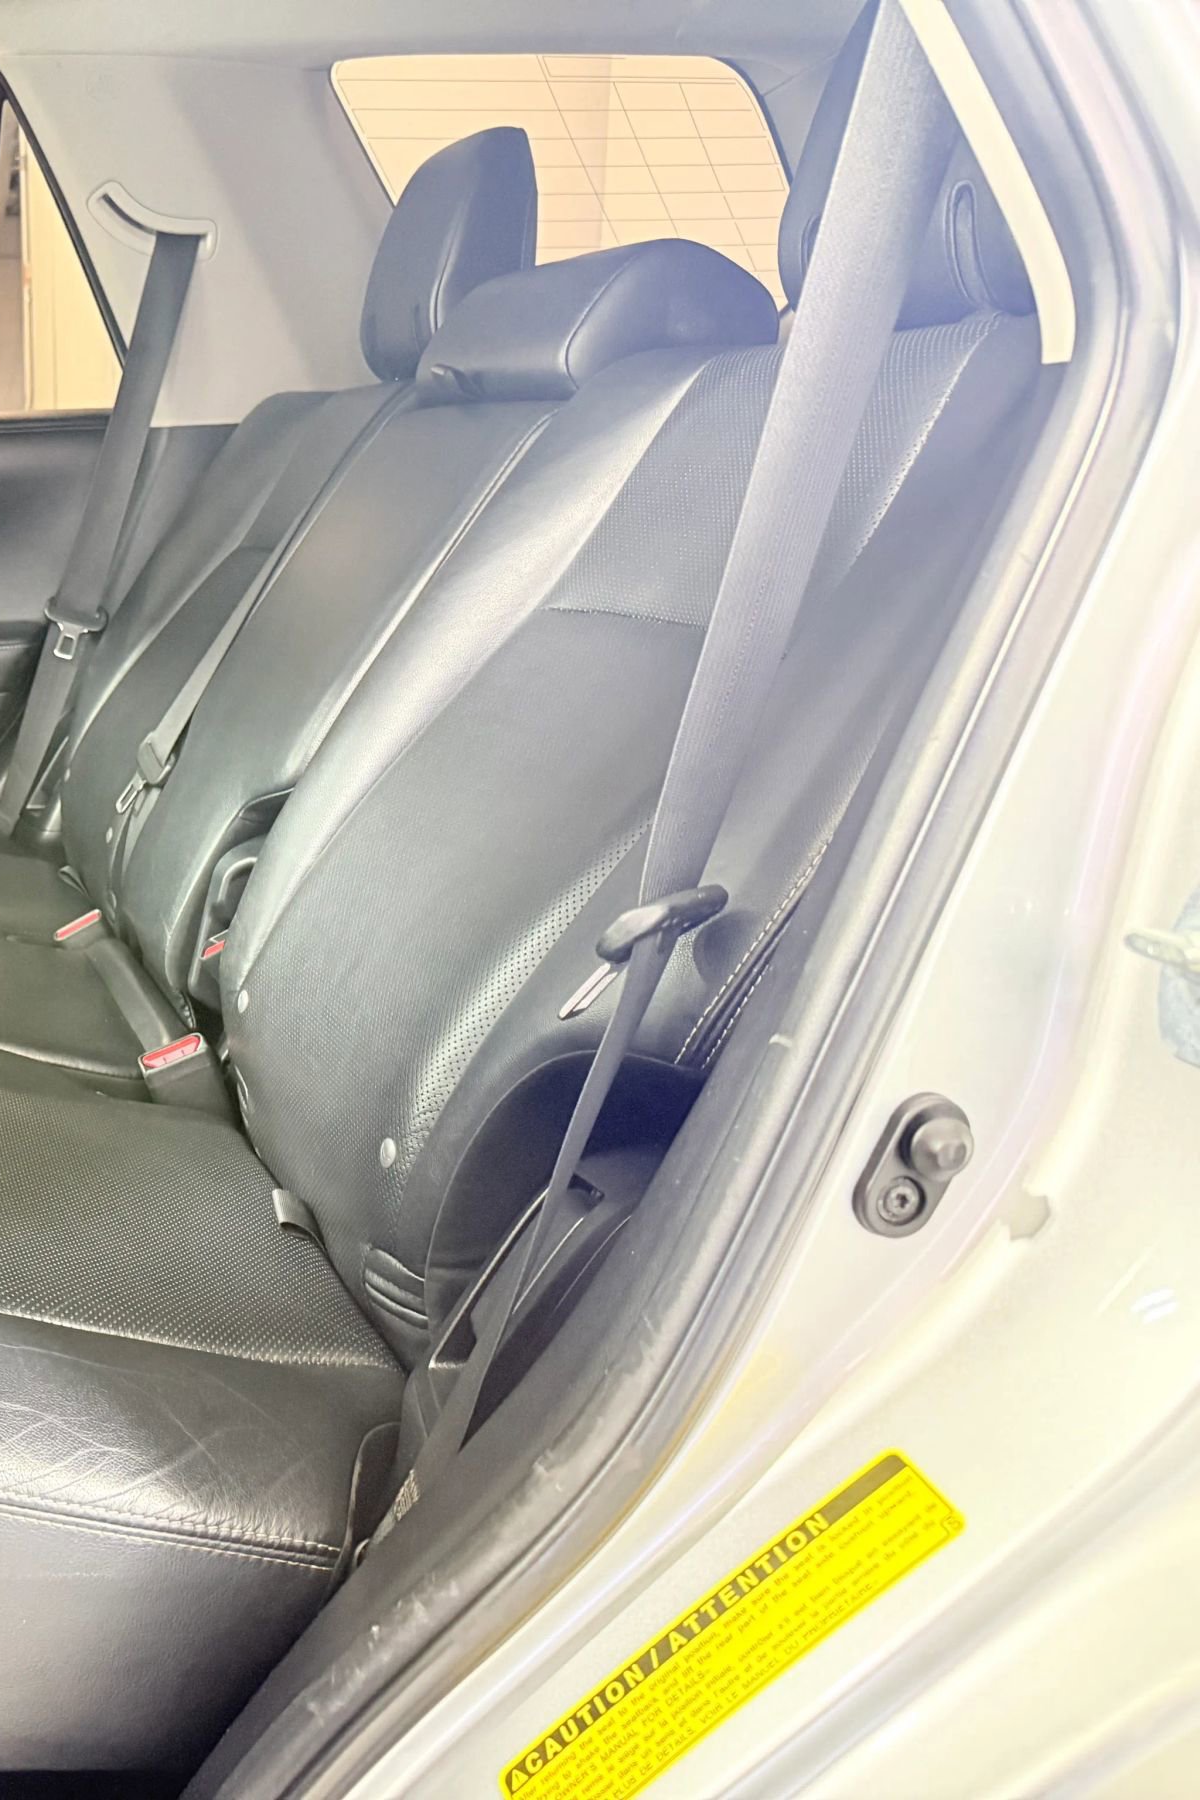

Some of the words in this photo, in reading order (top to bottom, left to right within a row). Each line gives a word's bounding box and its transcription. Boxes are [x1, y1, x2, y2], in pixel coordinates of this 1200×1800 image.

[525, 1663, 645, 1774] CAUTION
[649, 1647, 659, 1669] /
[668, 1512, 829, 1654] ATTENTION
